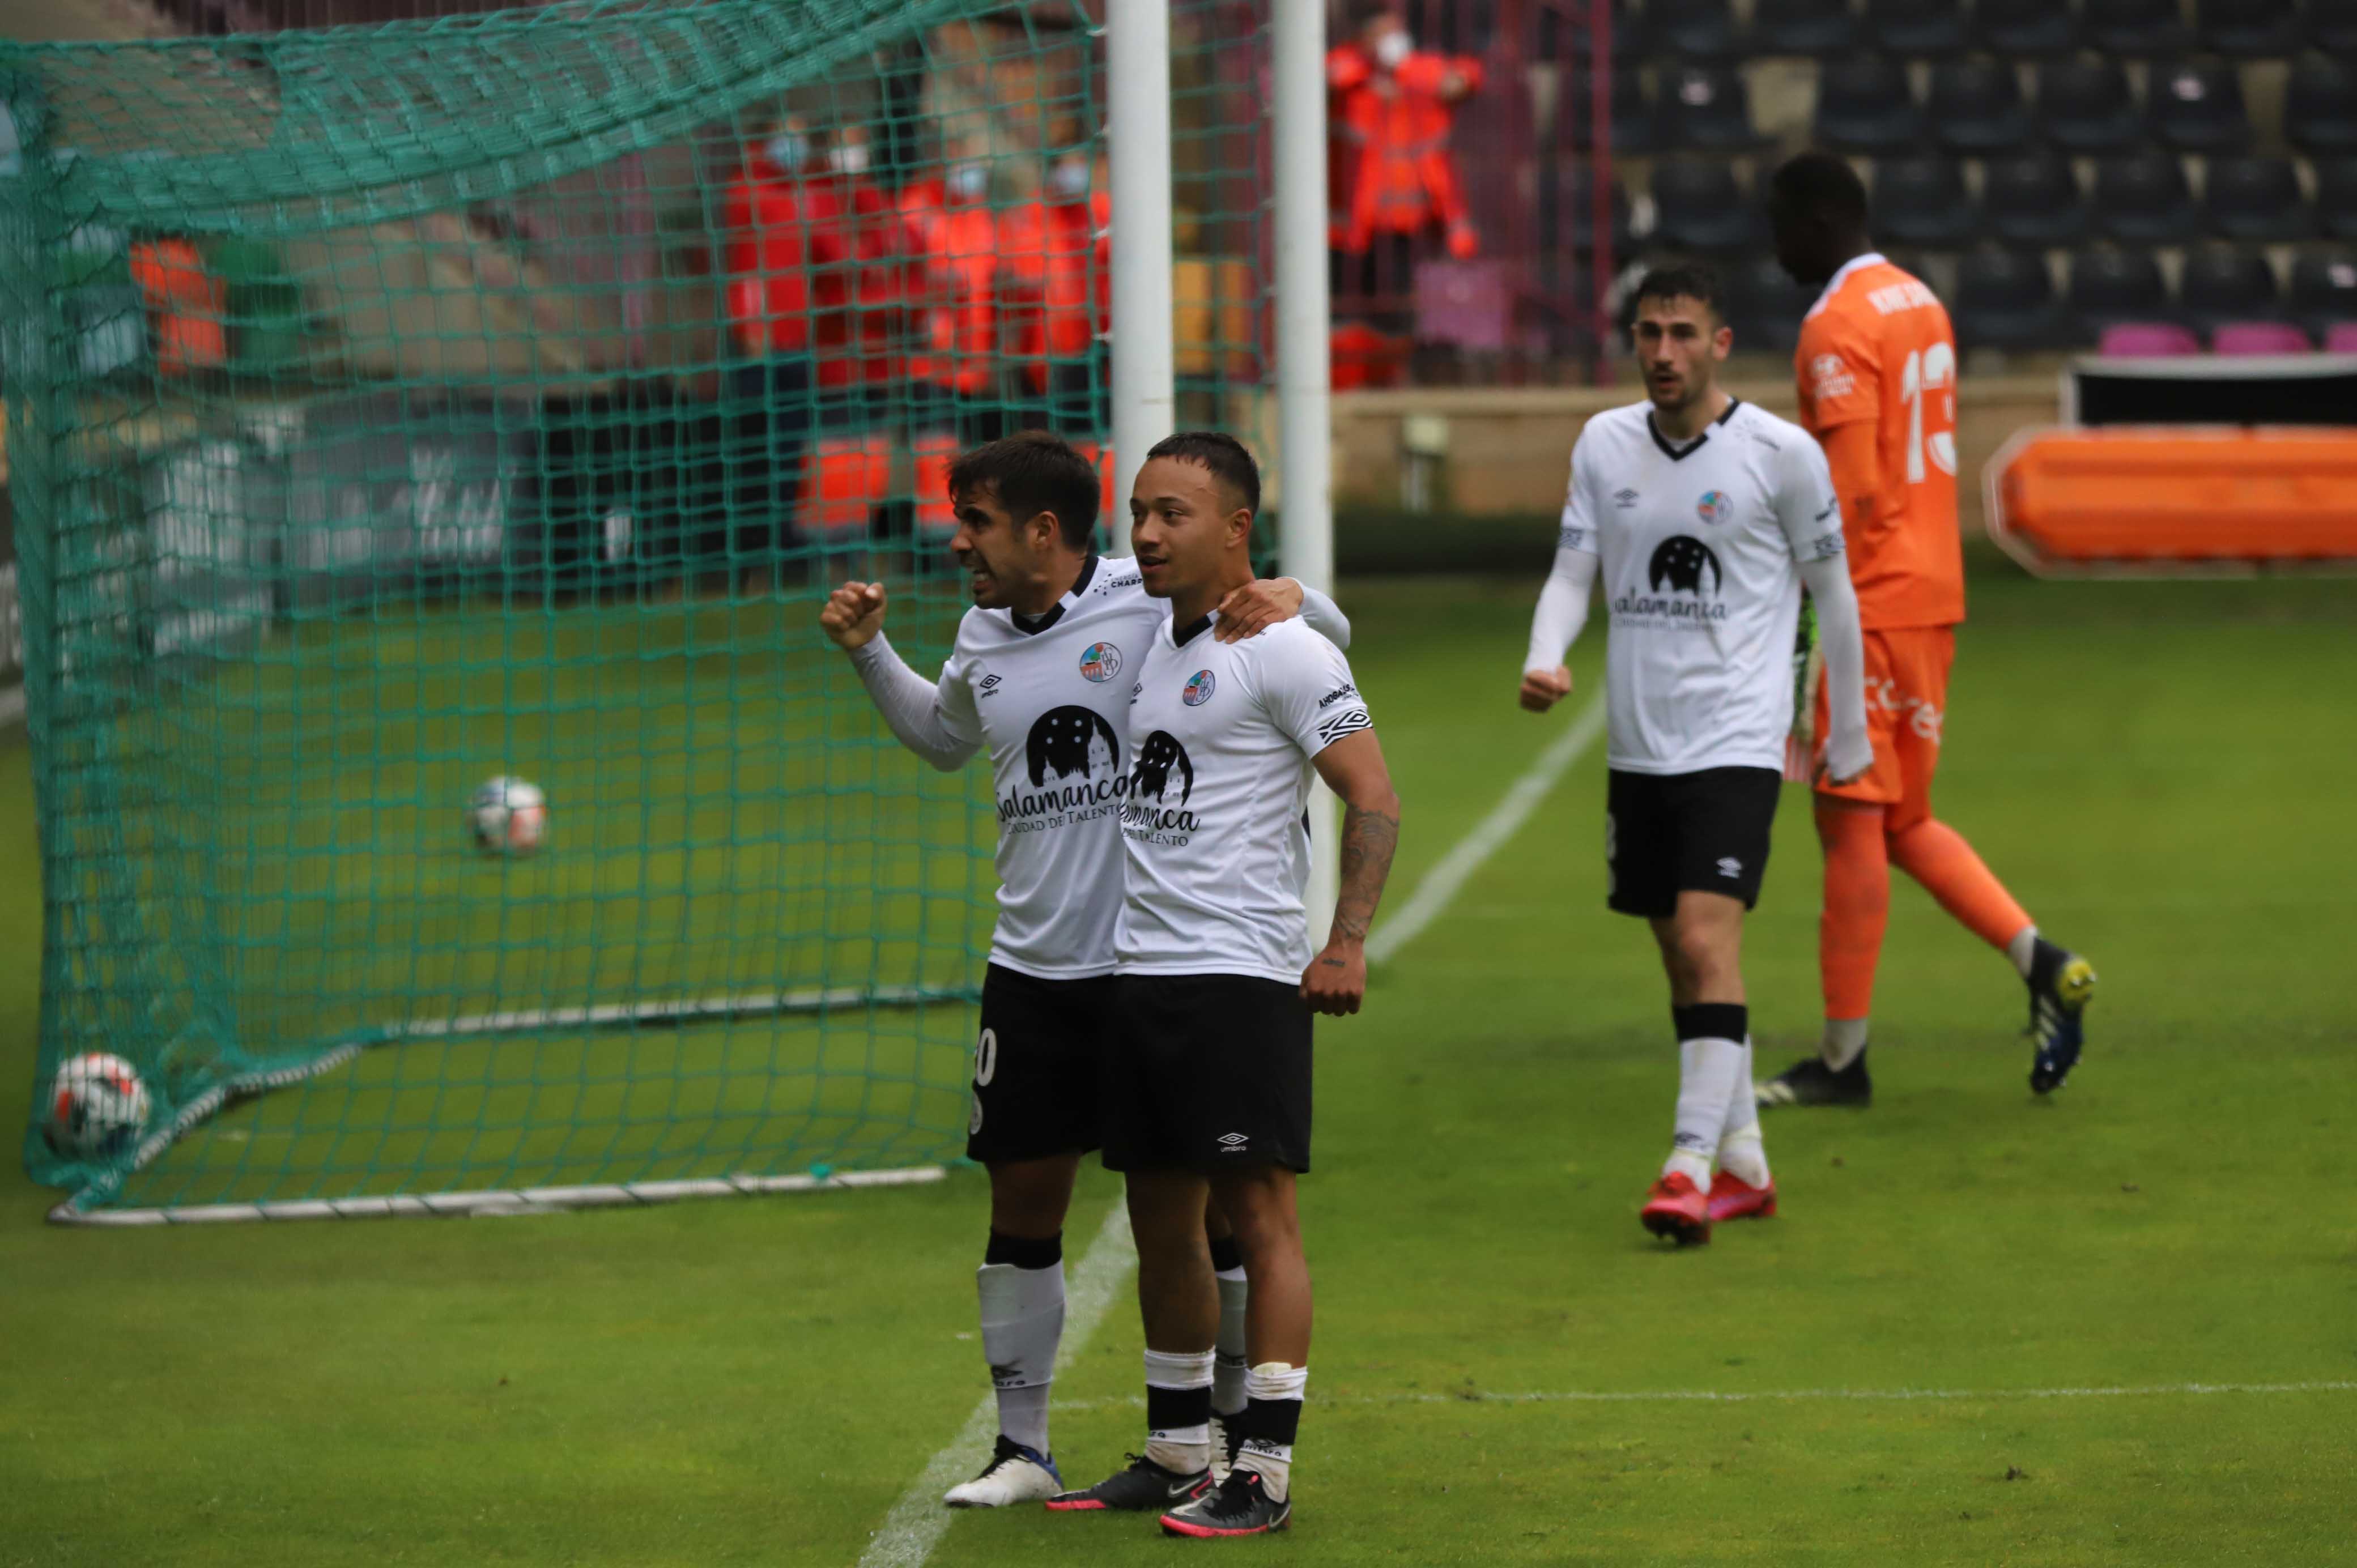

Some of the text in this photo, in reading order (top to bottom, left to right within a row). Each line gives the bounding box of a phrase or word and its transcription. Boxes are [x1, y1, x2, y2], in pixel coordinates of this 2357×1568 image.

[1901, 341, 1958, 484] 13
[1111, 578, 1143, 588] CHARR
[976, 1028, 997, 1087] 0
